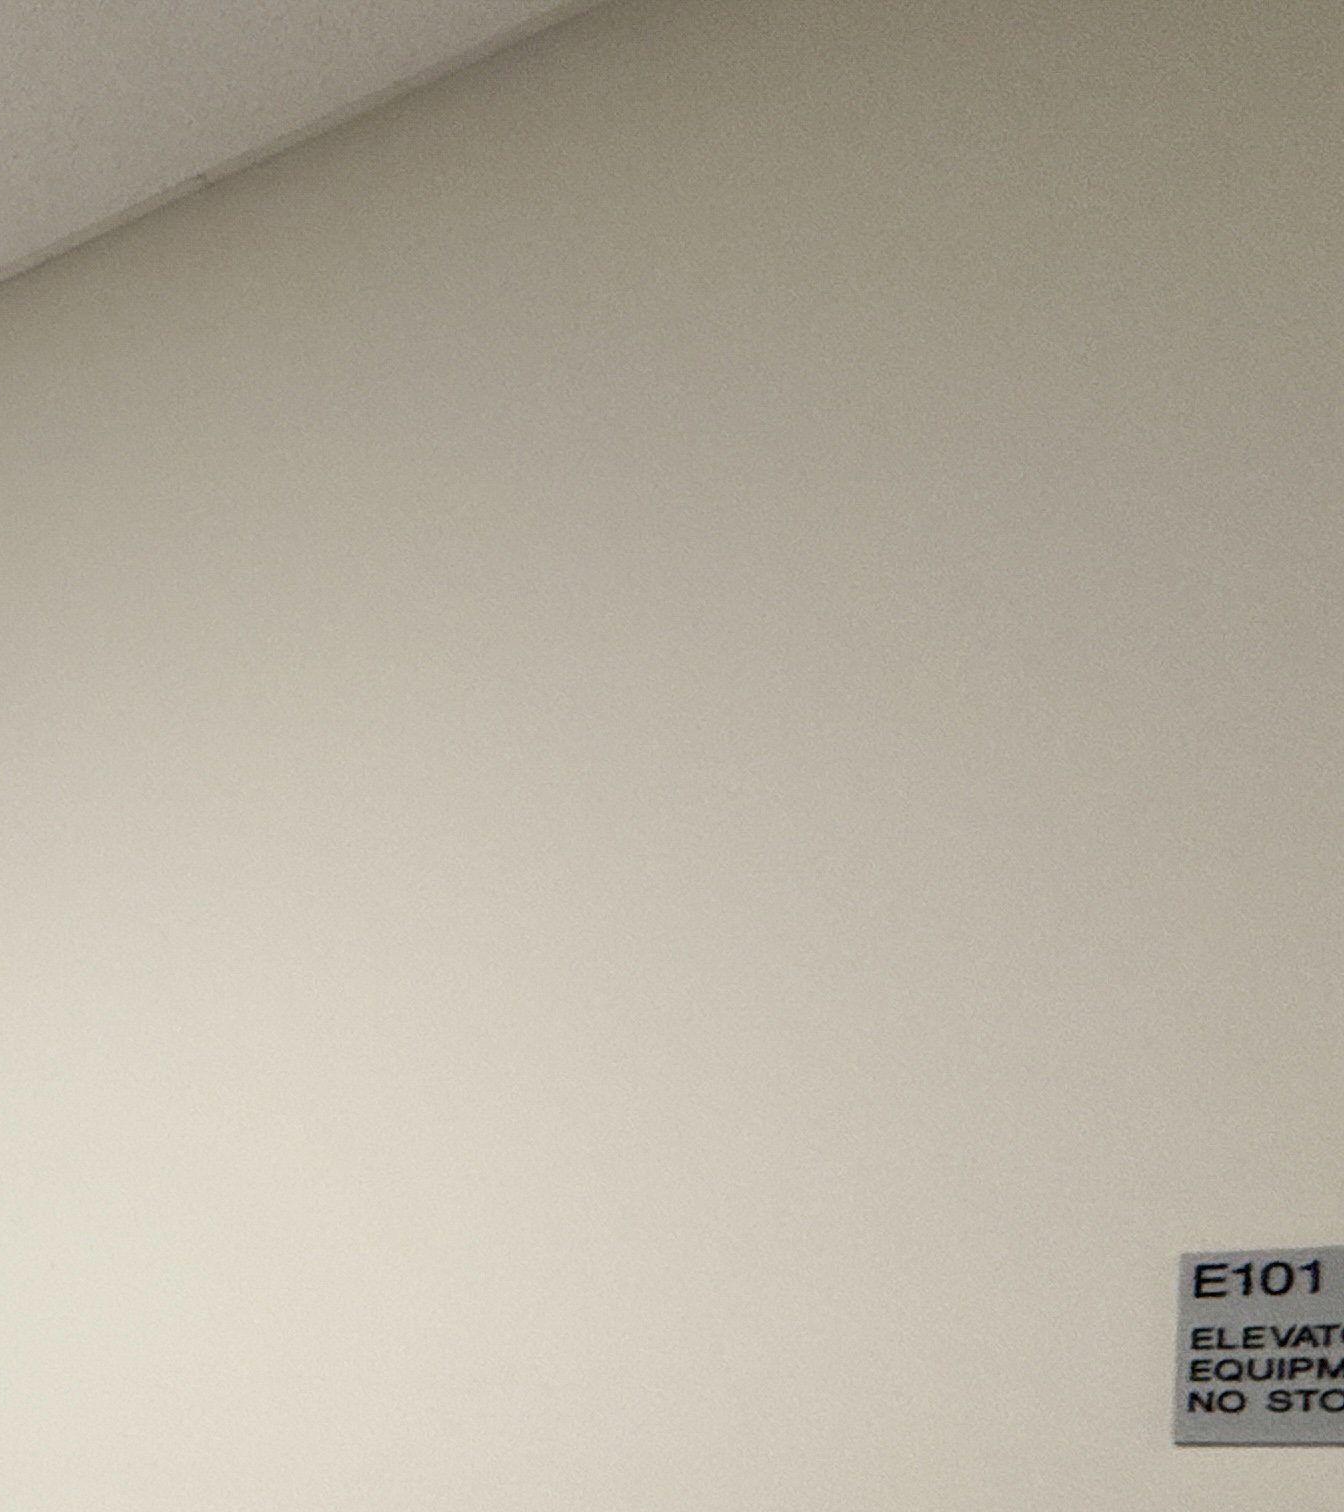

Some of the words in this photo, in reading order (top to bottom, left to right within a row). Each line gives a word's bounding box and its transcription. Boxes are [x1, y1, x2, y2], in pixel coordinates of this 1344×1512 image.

[1193, 1259, 1322, 1299] E101
[1189, 1323, 1344, 1350] ELEVAT
[1186, 1389, 1247, 1413] NO
[1265, 1388, 1344, 1413] STO
